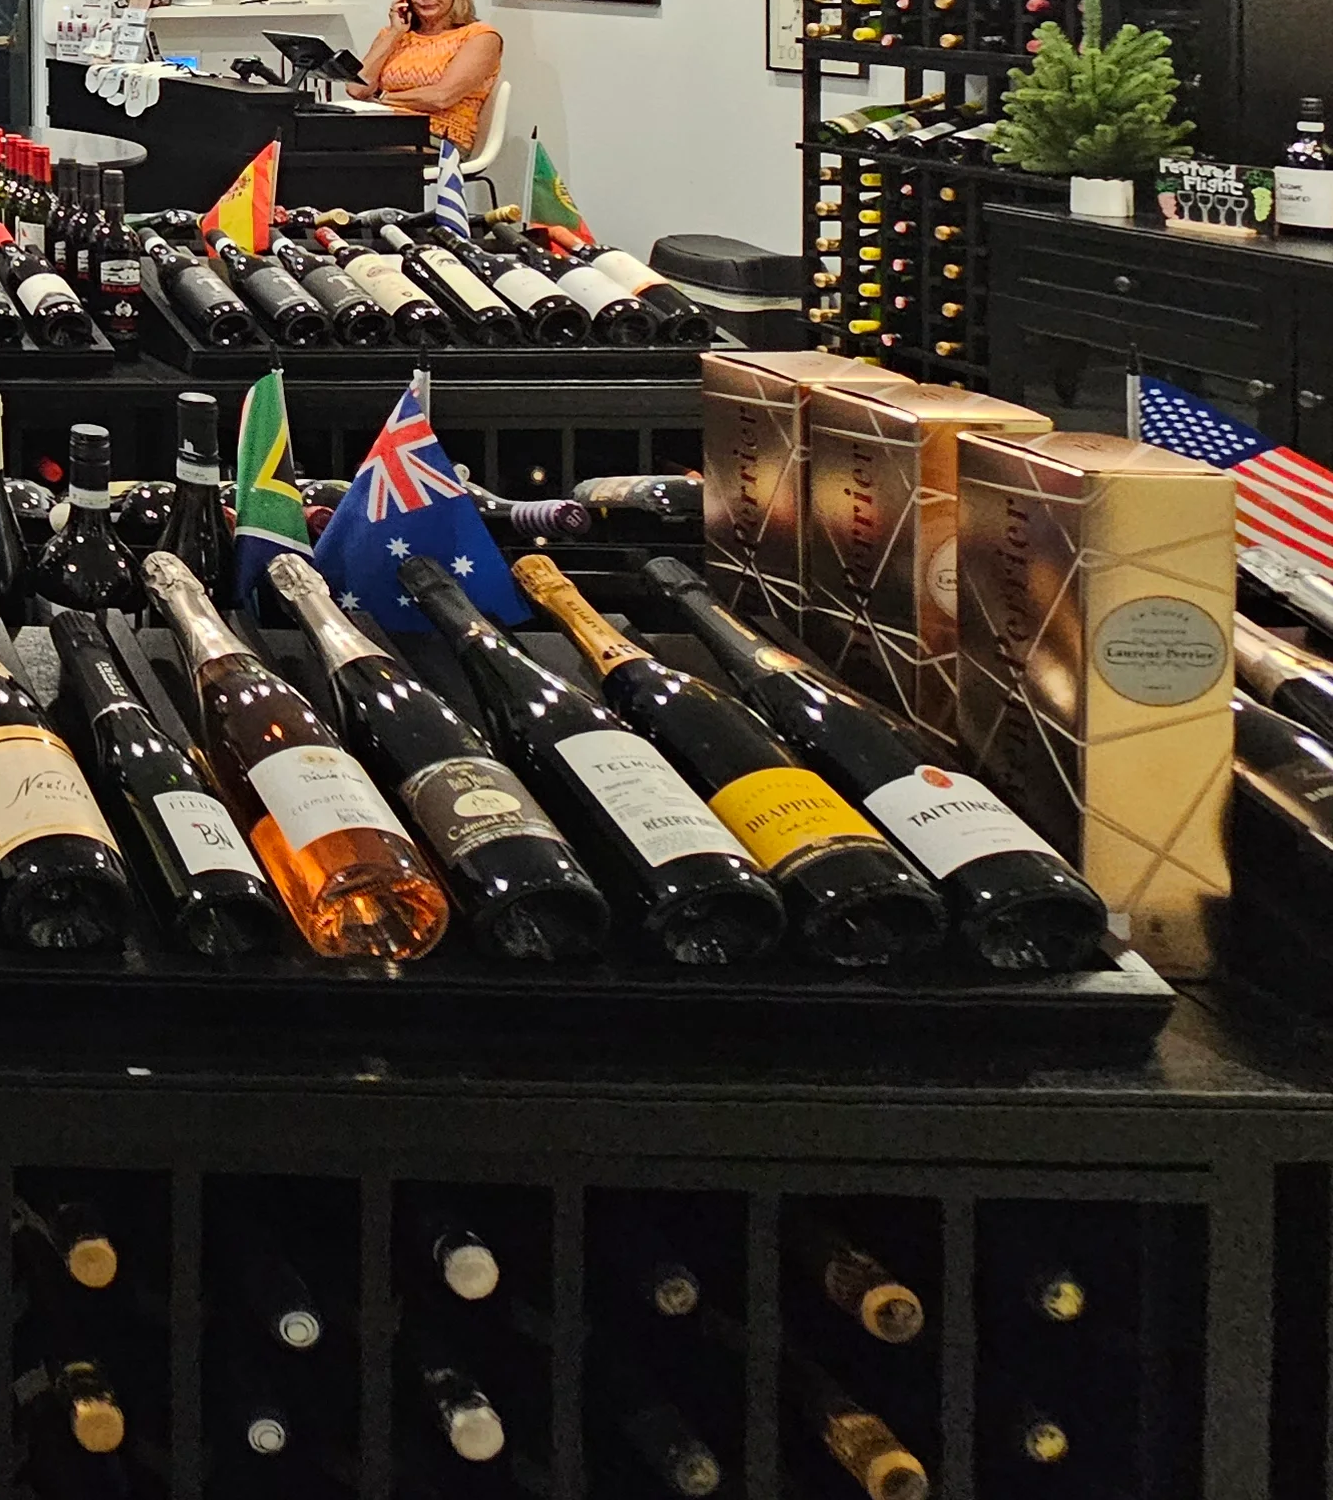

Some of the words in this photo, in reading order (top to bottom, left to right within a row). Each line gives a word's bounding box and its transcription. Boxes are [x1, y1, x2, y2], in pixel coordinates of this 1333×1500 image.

[1159, 157, 1237, 180] Featured
[1183, 175, 1245, 196] Flight
[642, 815, 697, 832] RÉSERVE
[744, 797, 837, 835] DRAPPIER
